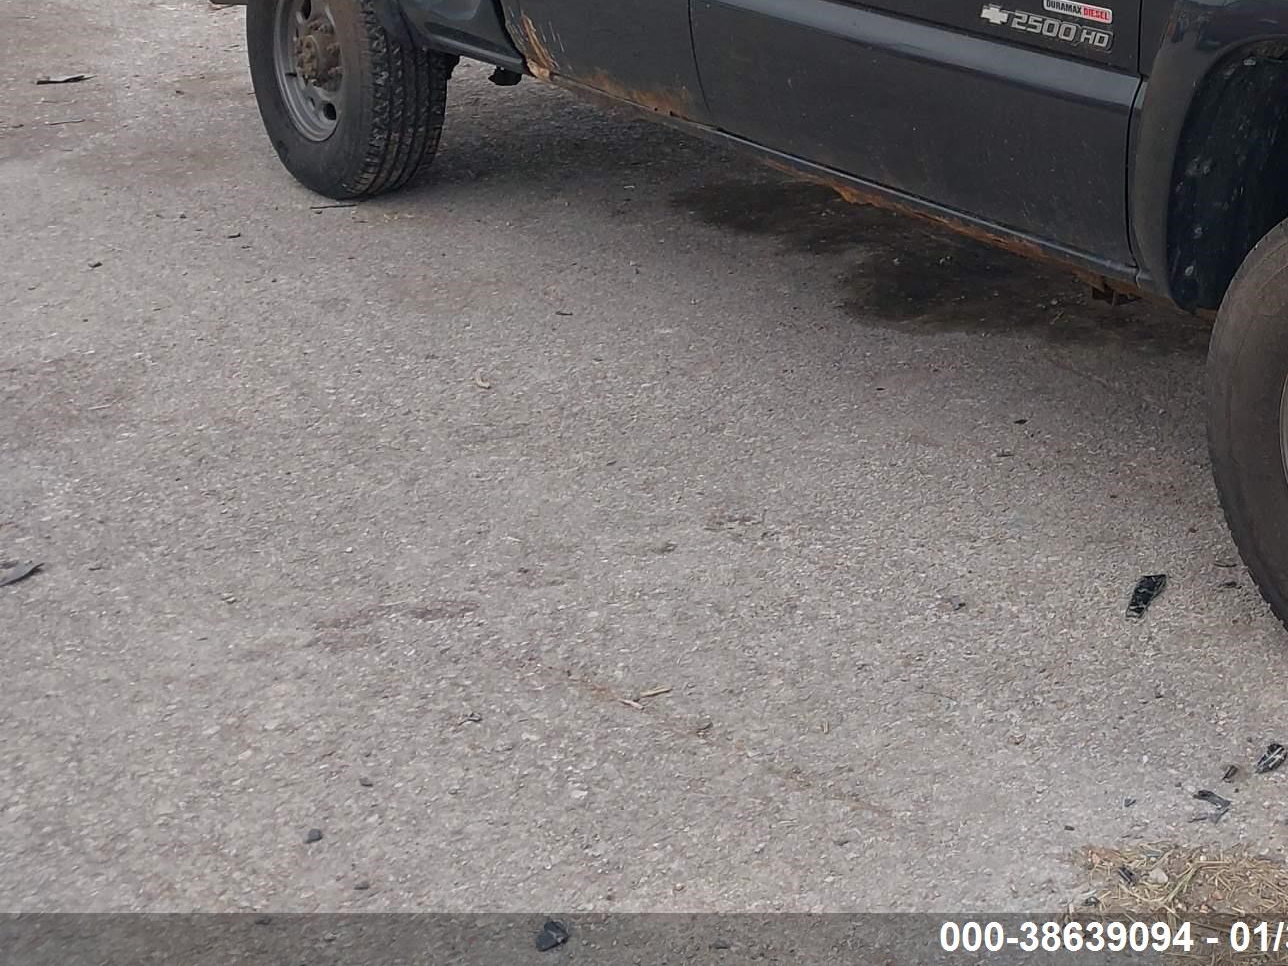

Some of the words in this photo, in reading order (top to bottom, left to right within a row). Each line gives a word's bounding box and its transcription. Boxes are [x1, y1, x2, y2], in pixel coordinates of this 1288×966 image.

[1046, 0, 1082, 15] DURAMAX
[1083, 7, 1110, 20] DIESEL
[1012, 12, 1077, 42] 2500
[1080, 29, 1110, 48] HD
